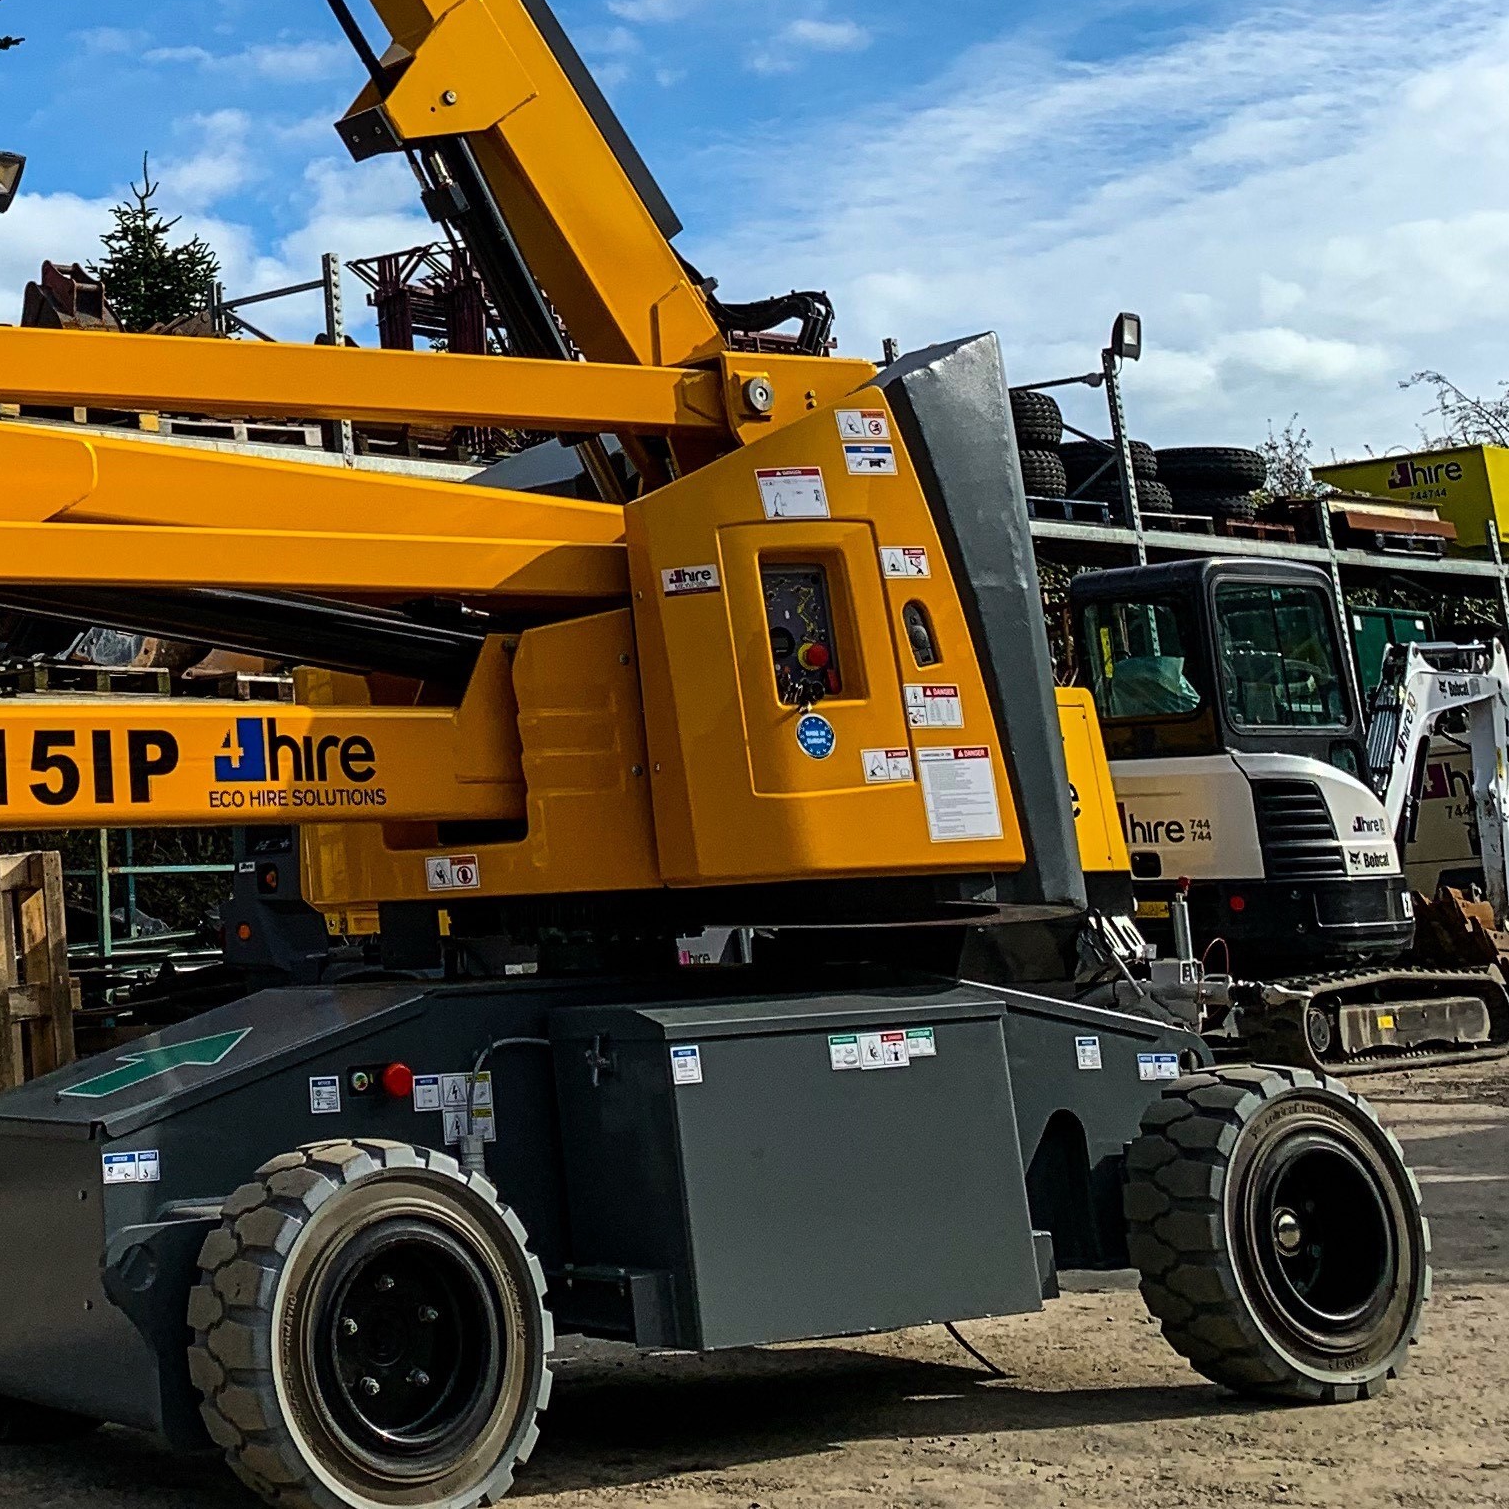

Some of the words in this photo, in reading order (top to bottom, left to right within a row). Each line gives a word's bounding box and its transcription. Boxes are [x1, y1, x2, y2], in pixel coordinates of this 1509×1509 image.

[209, 790, 244, 808] ECO
[249, 789, 289, 808] HIRE
[292, 788, 388, 807] SOLUTIONS
[1118, 811, 1186, 843] hire
[1189, 819, 1211, 830] 744
[1190, 830, 1212, 842] 744
